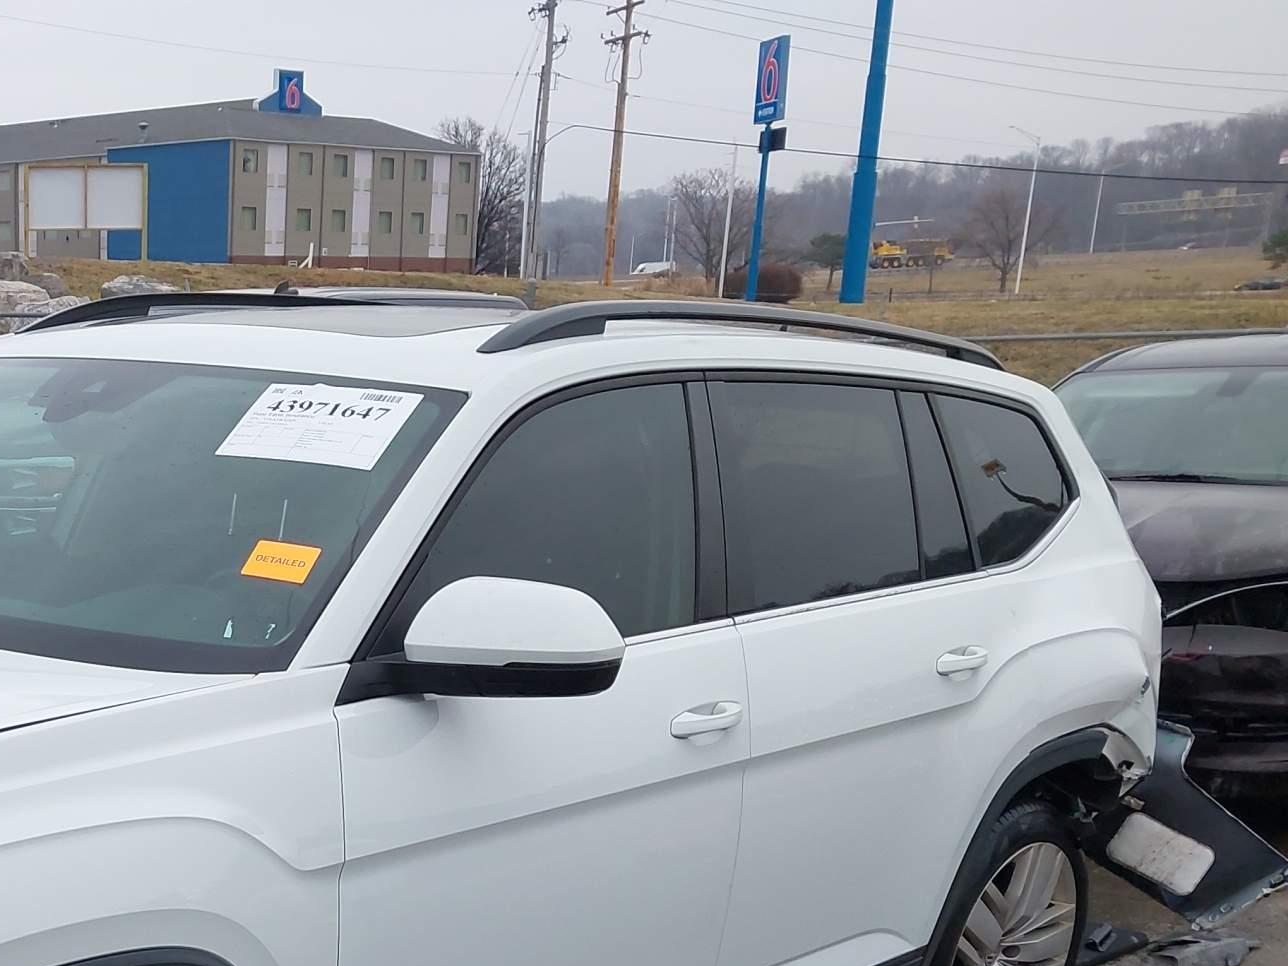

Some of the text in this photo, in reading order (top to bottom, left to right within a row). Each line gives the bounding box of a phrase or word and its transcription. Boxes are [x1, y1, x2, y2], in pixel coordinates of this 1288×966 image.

[761, 39, 780, 104] 6
[286, 78, 300, 110] 6
[266, 399, 392, 422] 43971647
[255, 554, 306, 568] DETAILED
